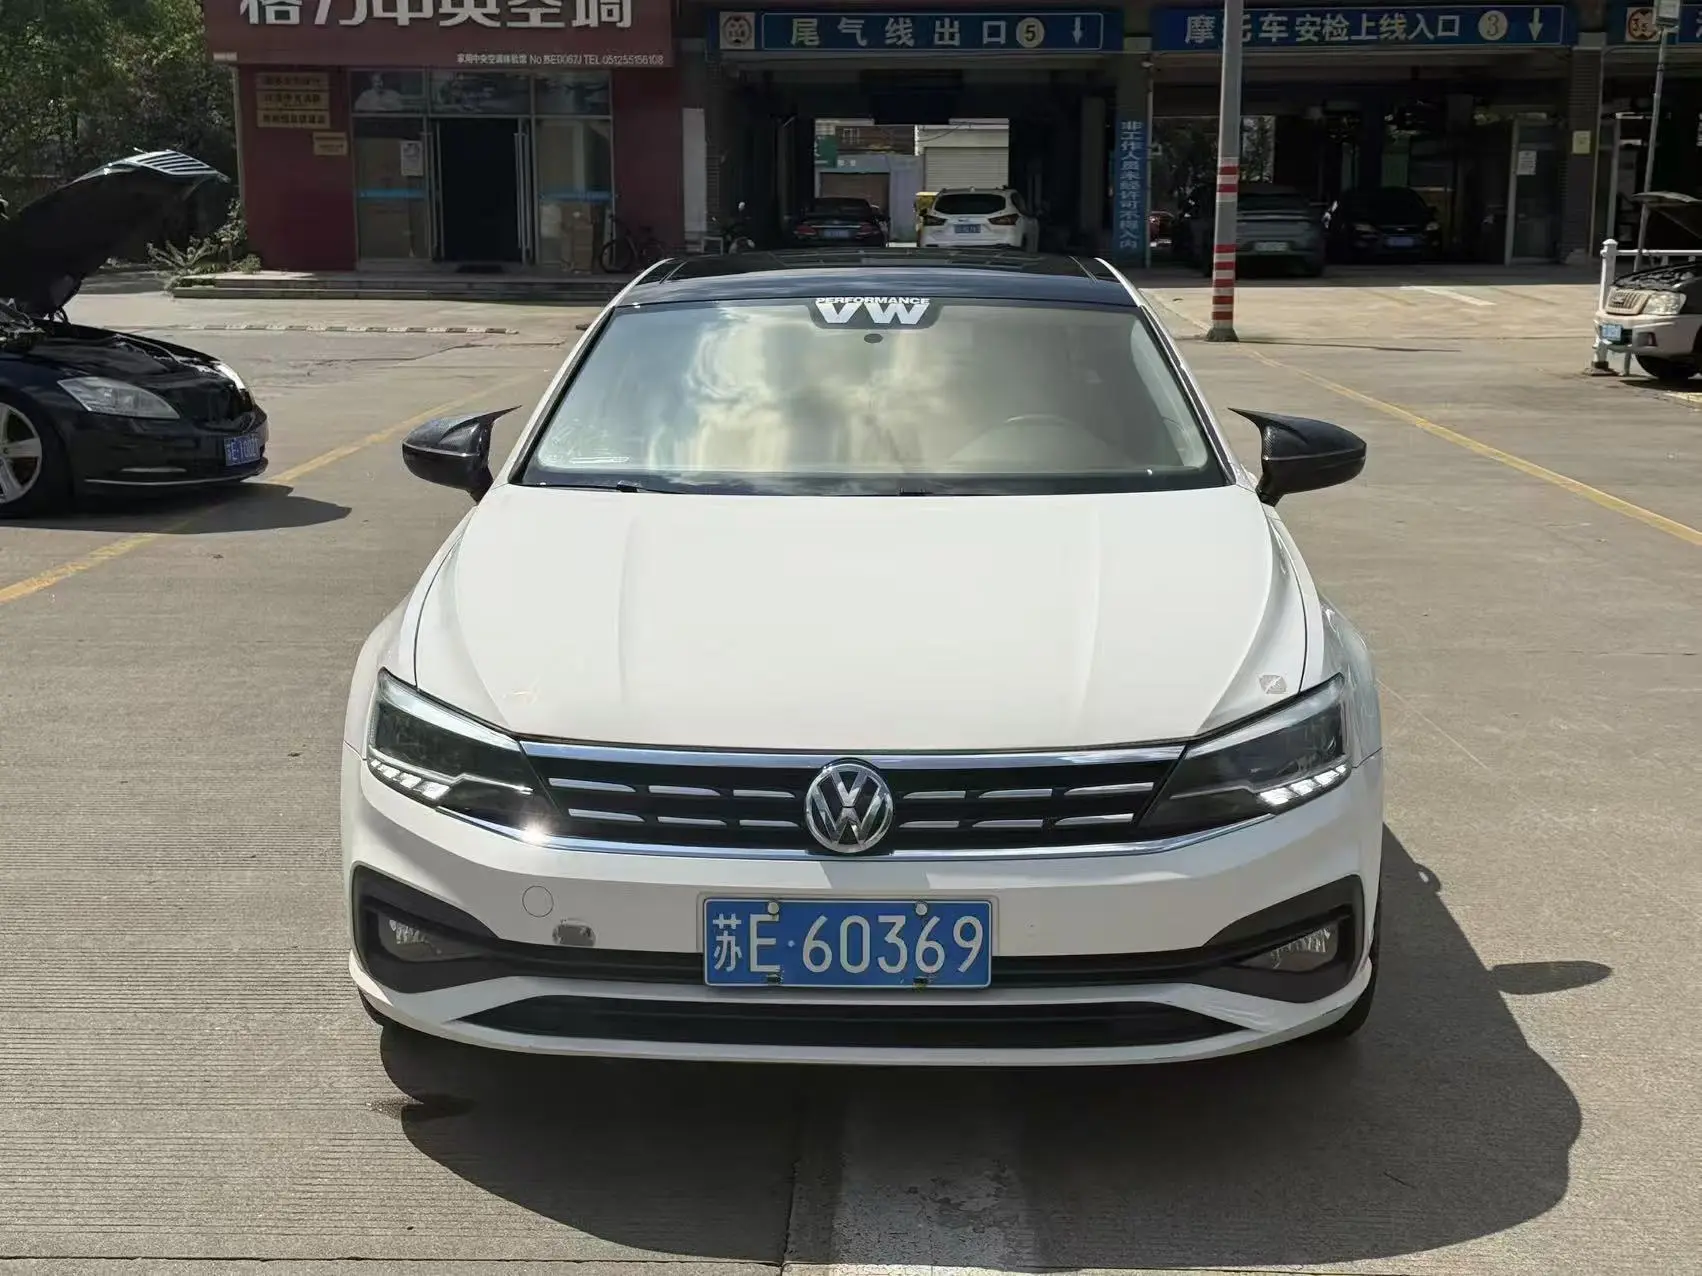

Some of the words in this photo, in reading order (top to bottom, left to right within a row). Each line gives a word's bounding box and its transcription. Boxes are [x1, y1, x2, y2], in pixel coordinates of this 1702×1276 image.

[790, 17, 1007, 47] 尾气线出口
[583, 54, 600, 65] TEL
[816, 303, 930, 324] VW
[711, 913, 982, 974] 苏E·60369
